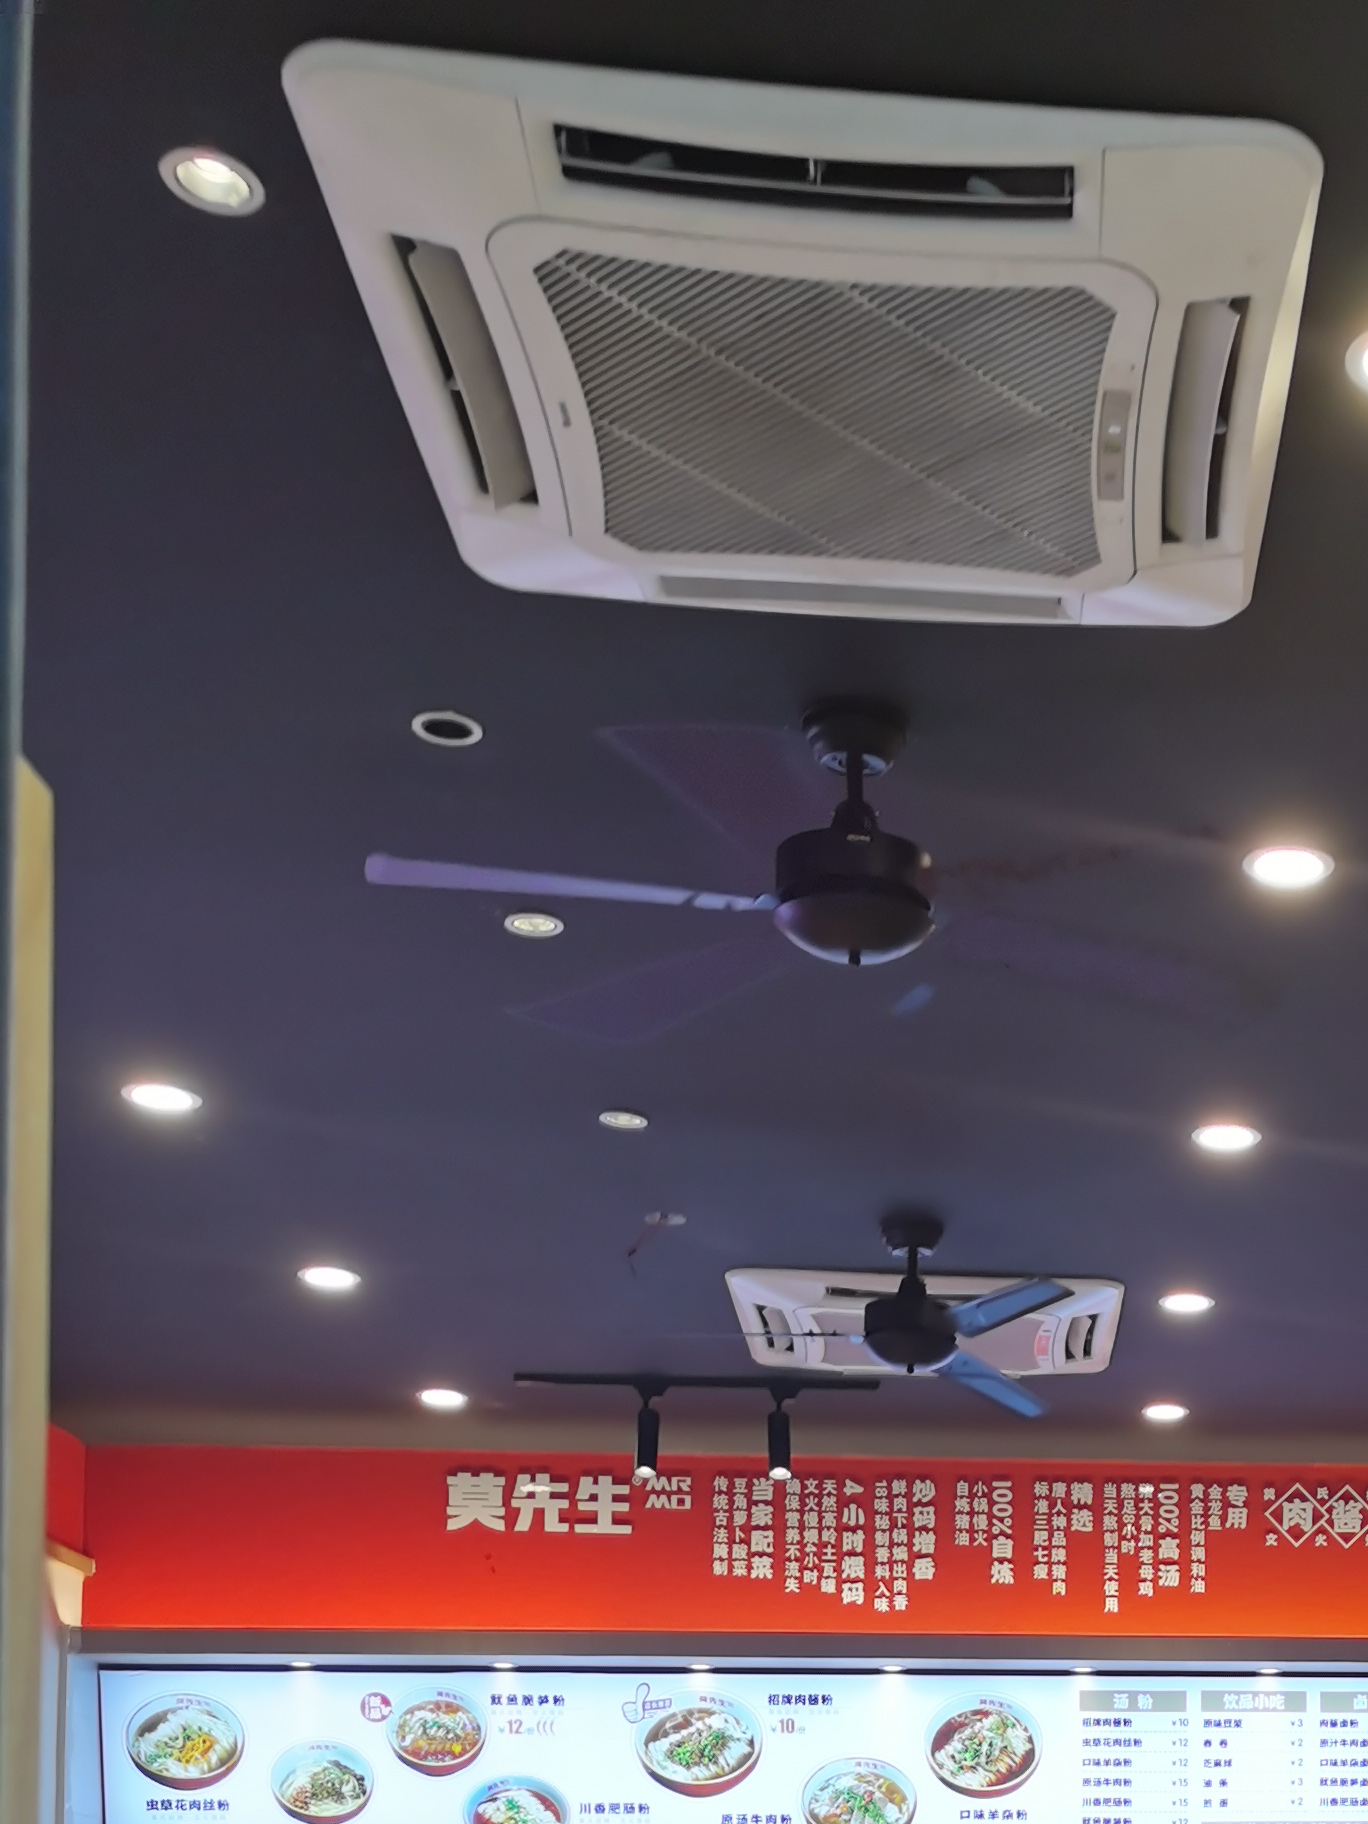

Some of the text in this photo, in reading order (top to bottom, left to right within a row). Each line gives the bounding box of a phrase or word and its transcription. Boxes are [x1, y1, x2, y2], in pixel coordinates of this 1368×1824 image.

[446, 1472, 632, 1534] 莫先生
[645, 1476, 692, 1491] MR
[645, 1494, 692, 1510] MO
[712, 1475, 729, 1576] 传统古法腌制
[732, 1477, 748, 1577] 豆角萝卜酸菜
[750, 1477, 774, 1579] 当家配菜
[912, 1479, 936, 1580] 炒码增香
[954, 1480, 970, 1547] 自炼猪油
[972, 1480, 988, 1547] 小锅慢火
[990, 1480, 1015, 1585] 100%自炼
[1033, 1481, 1049, 1580] 标准三肥七瘦
[1069, 1481, 1093, 1532] 精选
[1120, 1482, 1136, 1556] 熬足8小时
[1208, 1483, 1223, 1530] 金龙鱼
[1225, 1483, 1249, 1529] 专用
[785, 1478, 801, 1593] 确保营养不流失
[820, 1479, 837, 1594] 天然高岭土瓦罐
[841, 1478, 865, 1605] 4小时煨码
[873, 1479, 890, 1612] 18味秘制香料入味
[1051, 1481, 1067, 1596] 唐人神品牌猪肉
[1103, 1482, 1119, 1613] 当天熬制当天使用
[1157, 1483, 1180, 1588] 100%高汤
[1189, 1483, 1206, 1594] 黄金比例调和油
[768, 1693, 833, 1706] 招牌肉酱粉
[1223, 1693, 1286, 1710] 饮品小吃
[146, 1798, 230, 1811] 虫草花肉丝粉
